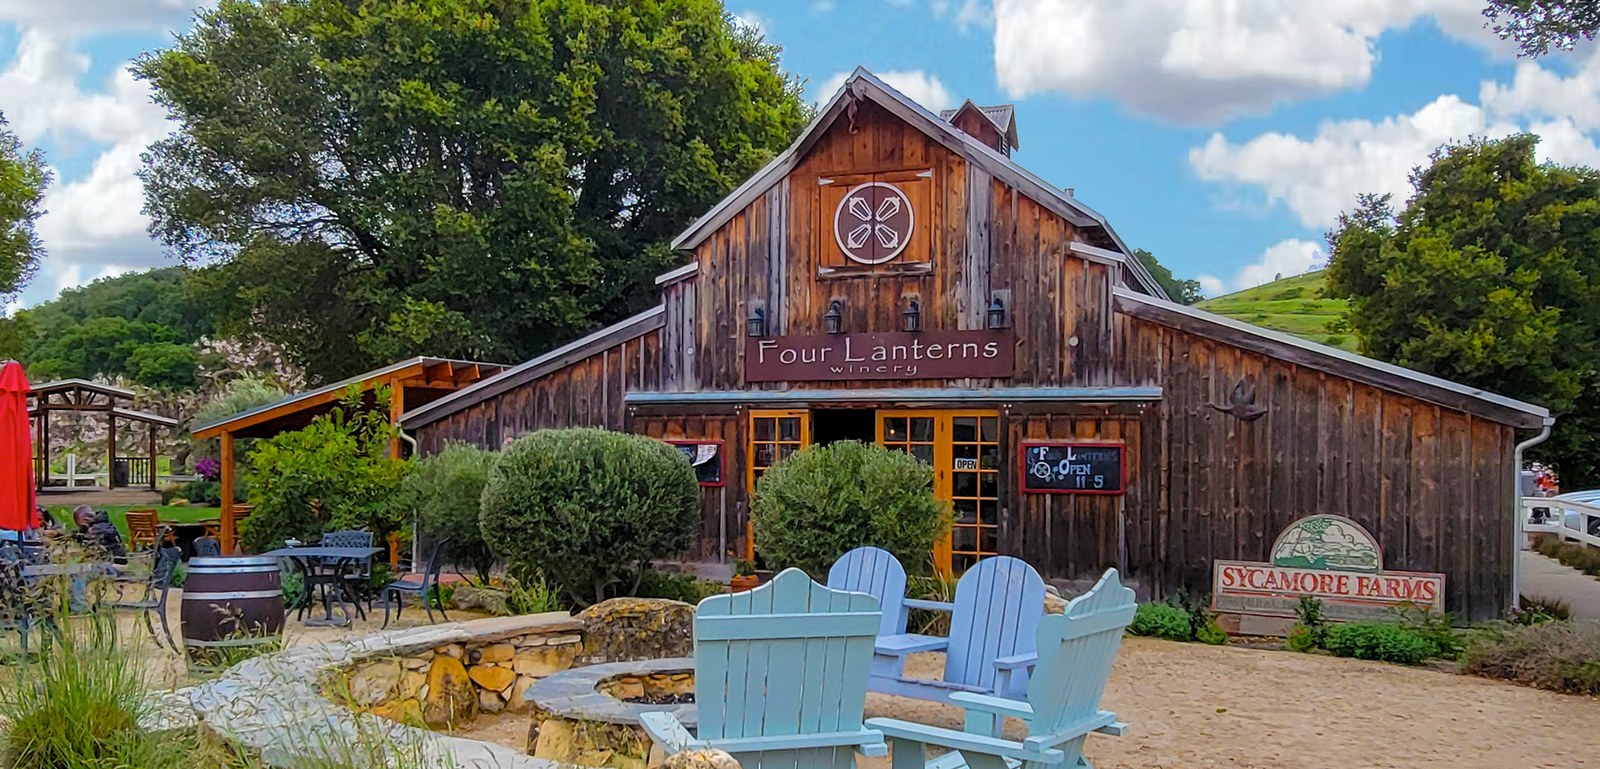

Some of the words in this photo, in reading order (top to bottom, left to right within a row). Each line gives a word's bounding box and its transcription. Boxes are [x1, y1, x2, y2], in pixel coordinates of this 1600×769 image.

[758, 339, 832, 364] Four
[845, 337, 999, 362] Lanterns
[830, 364, 919, 376] winery
[957, 459, 977, 469] OPEN
[1222, 566, 1349, 593] SYCAMORE
[1356, 575, 1436, 600] FARMS
